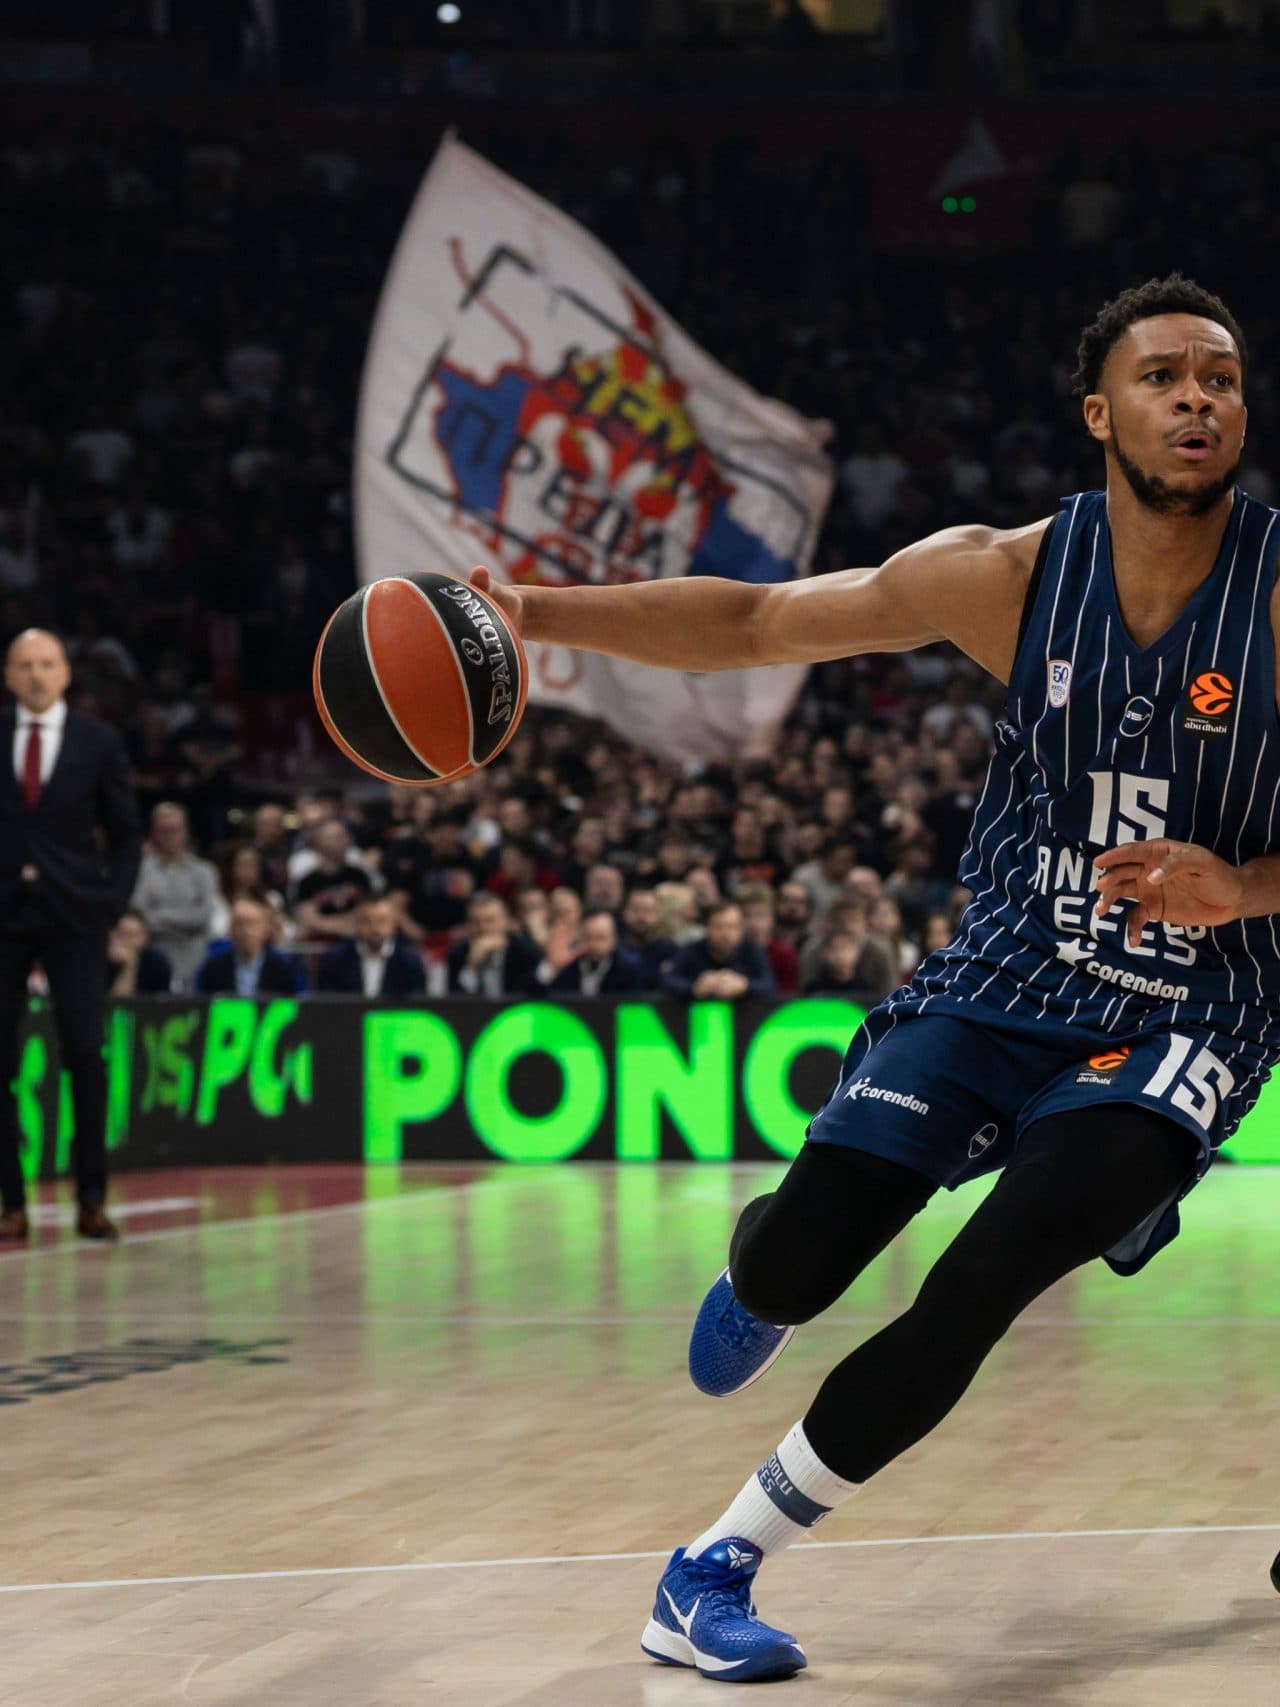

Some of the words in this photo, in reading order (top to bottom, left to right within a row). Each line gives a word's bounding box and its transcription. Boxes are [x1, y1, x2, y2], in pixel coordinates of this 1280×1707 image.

[438, 584, 513, 725] SPALDING
[1087, 771, 1170, 847] 15
[1086, 960, 1189, 1001] corendon
[860, 1086, 930, 1116] corendon
[1142, 1032, 1235, 1131] 15
